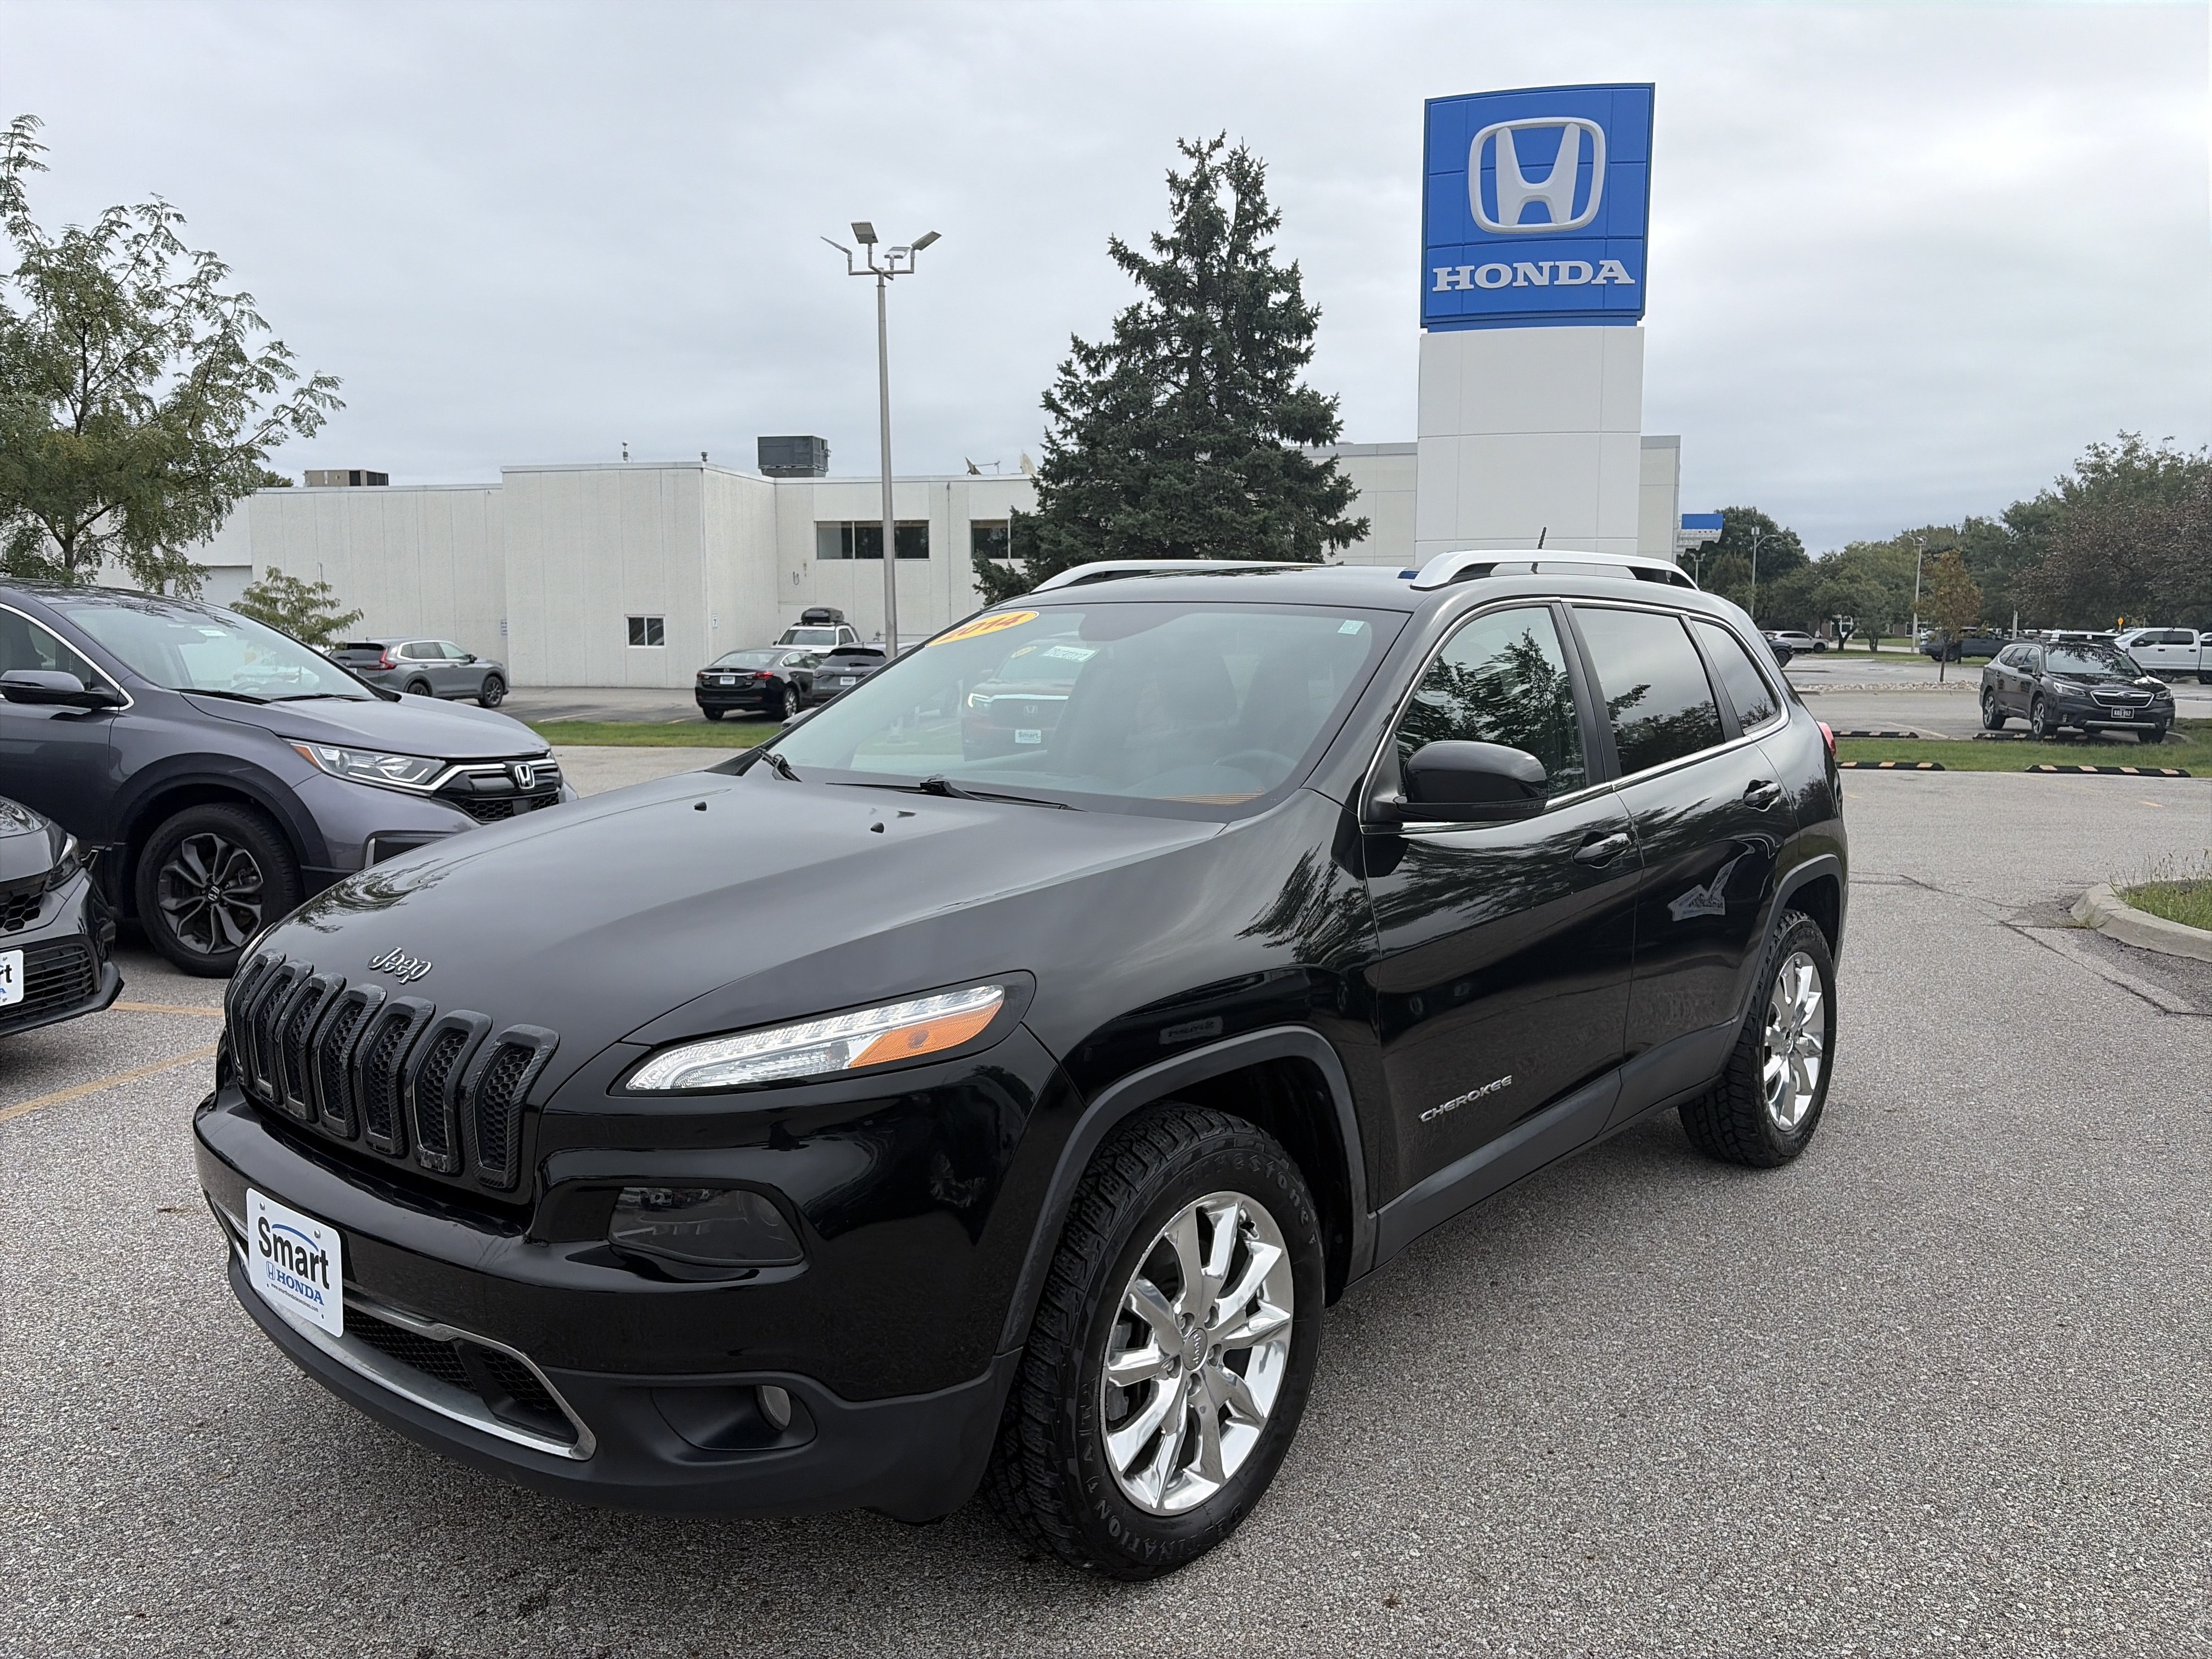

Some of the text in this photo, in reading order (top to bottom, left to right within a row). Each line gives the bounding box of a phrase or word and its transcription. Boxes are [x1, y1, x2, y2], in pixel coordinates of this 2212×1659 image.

[1432, 259, 1635, 292] HONDA
[934, 613, 1028, 644] 2014
[368, 947, 432, 985] Jeep
[1419, 1075, 1513, 1122] CHEROKEE
[258, 1216, 329, 1290] Smart
[276, 1270, 325, 1306] HONDA
